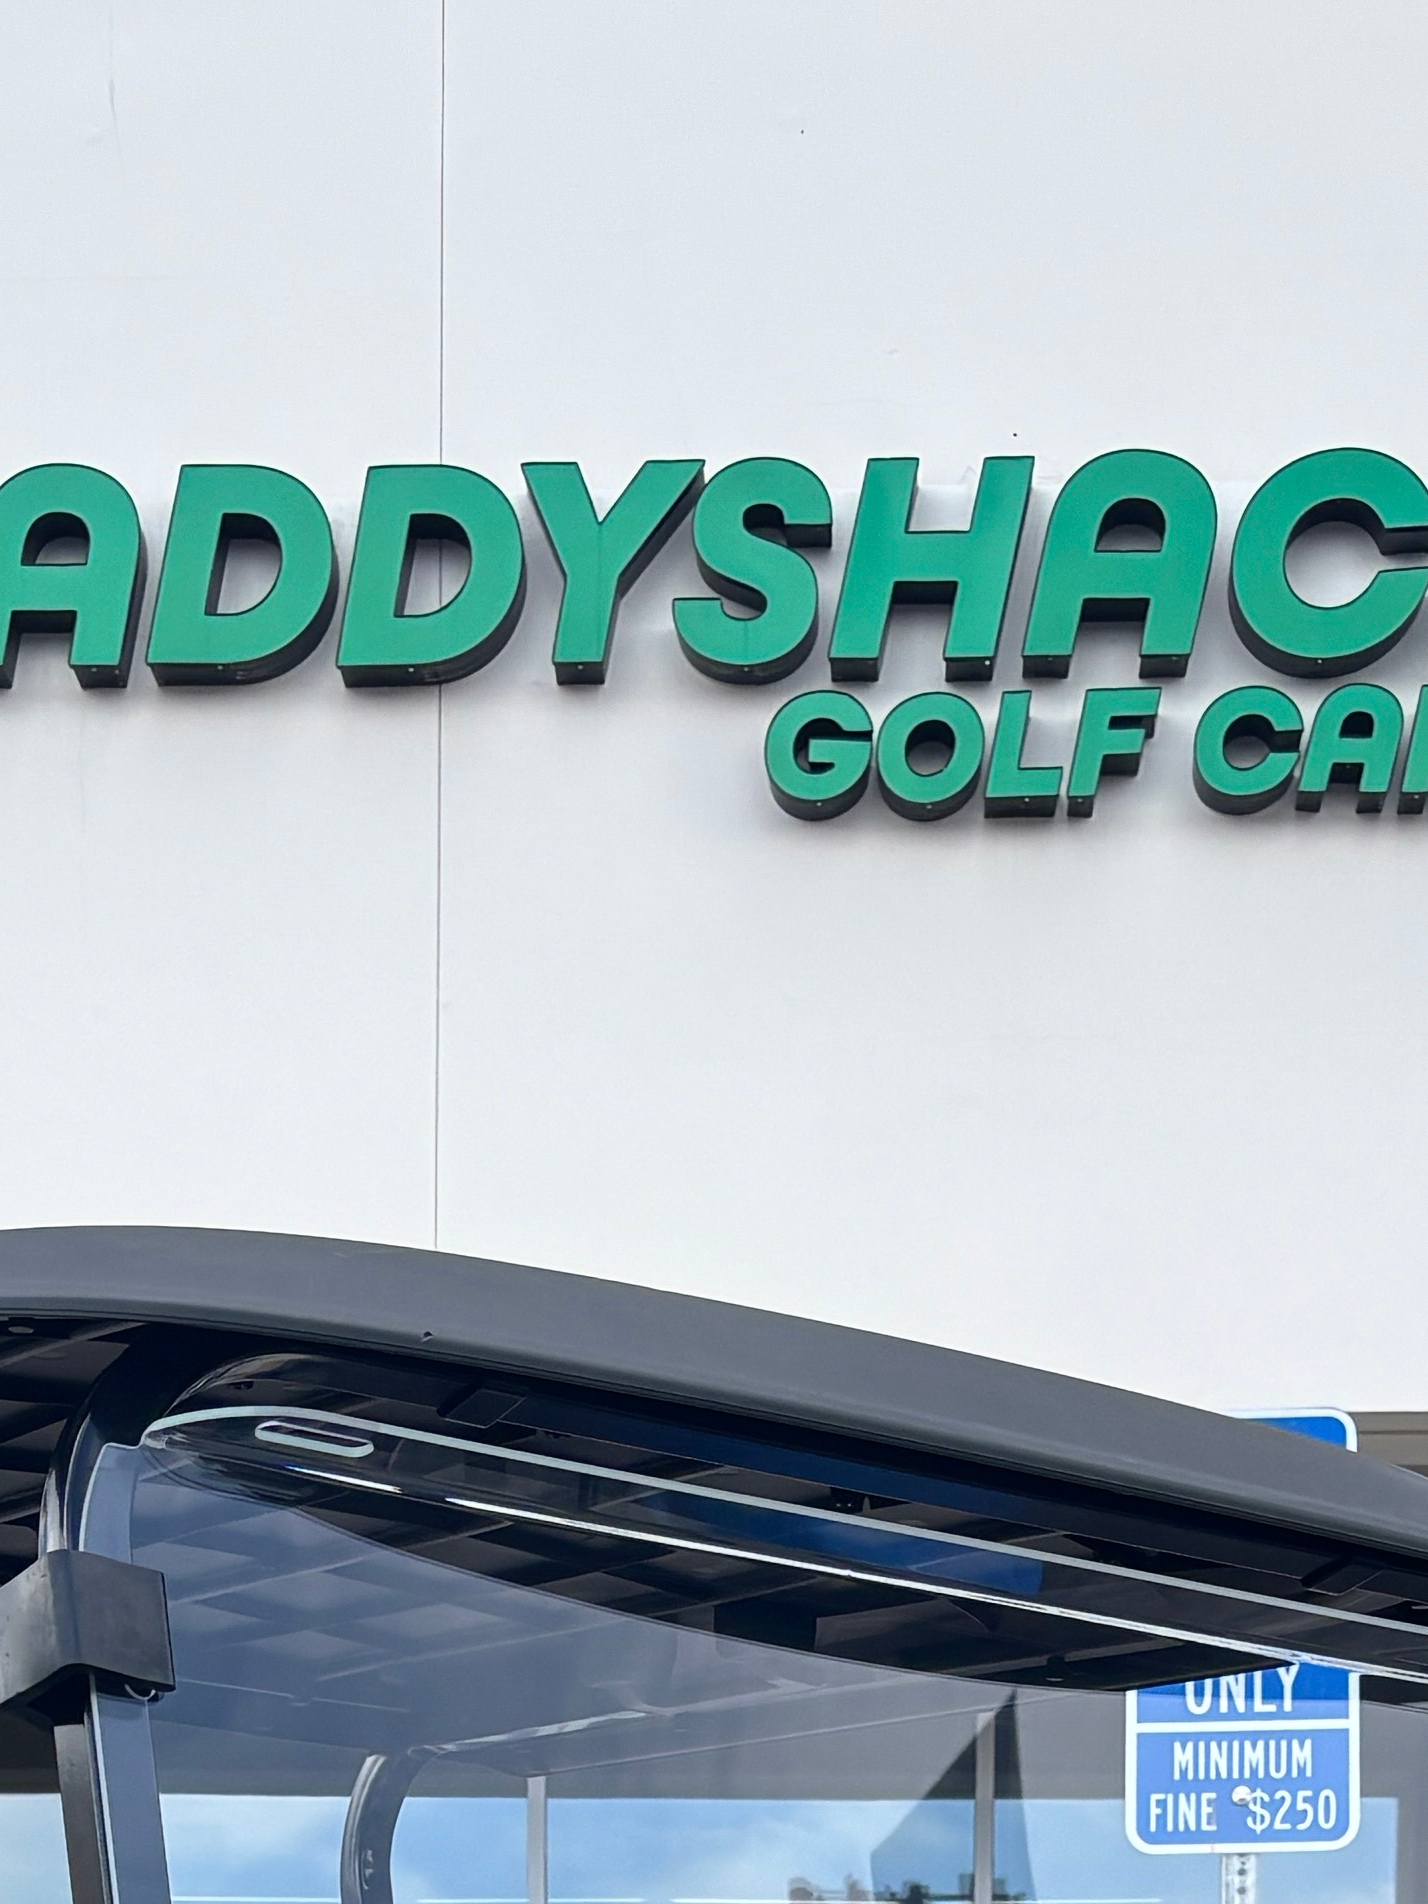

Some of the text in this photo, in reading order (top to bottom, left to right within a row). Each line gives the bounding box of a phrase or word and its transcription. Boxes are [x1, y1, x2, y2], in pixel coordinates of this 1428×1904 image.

[764, 688, 1164, 812] GOLF
[1184, 1664, 1301, 1716] ONLY
[1172, 1737, 1313, 1782] MINIMUM
[1148, 1787, 1338, 1836] FINE $250
